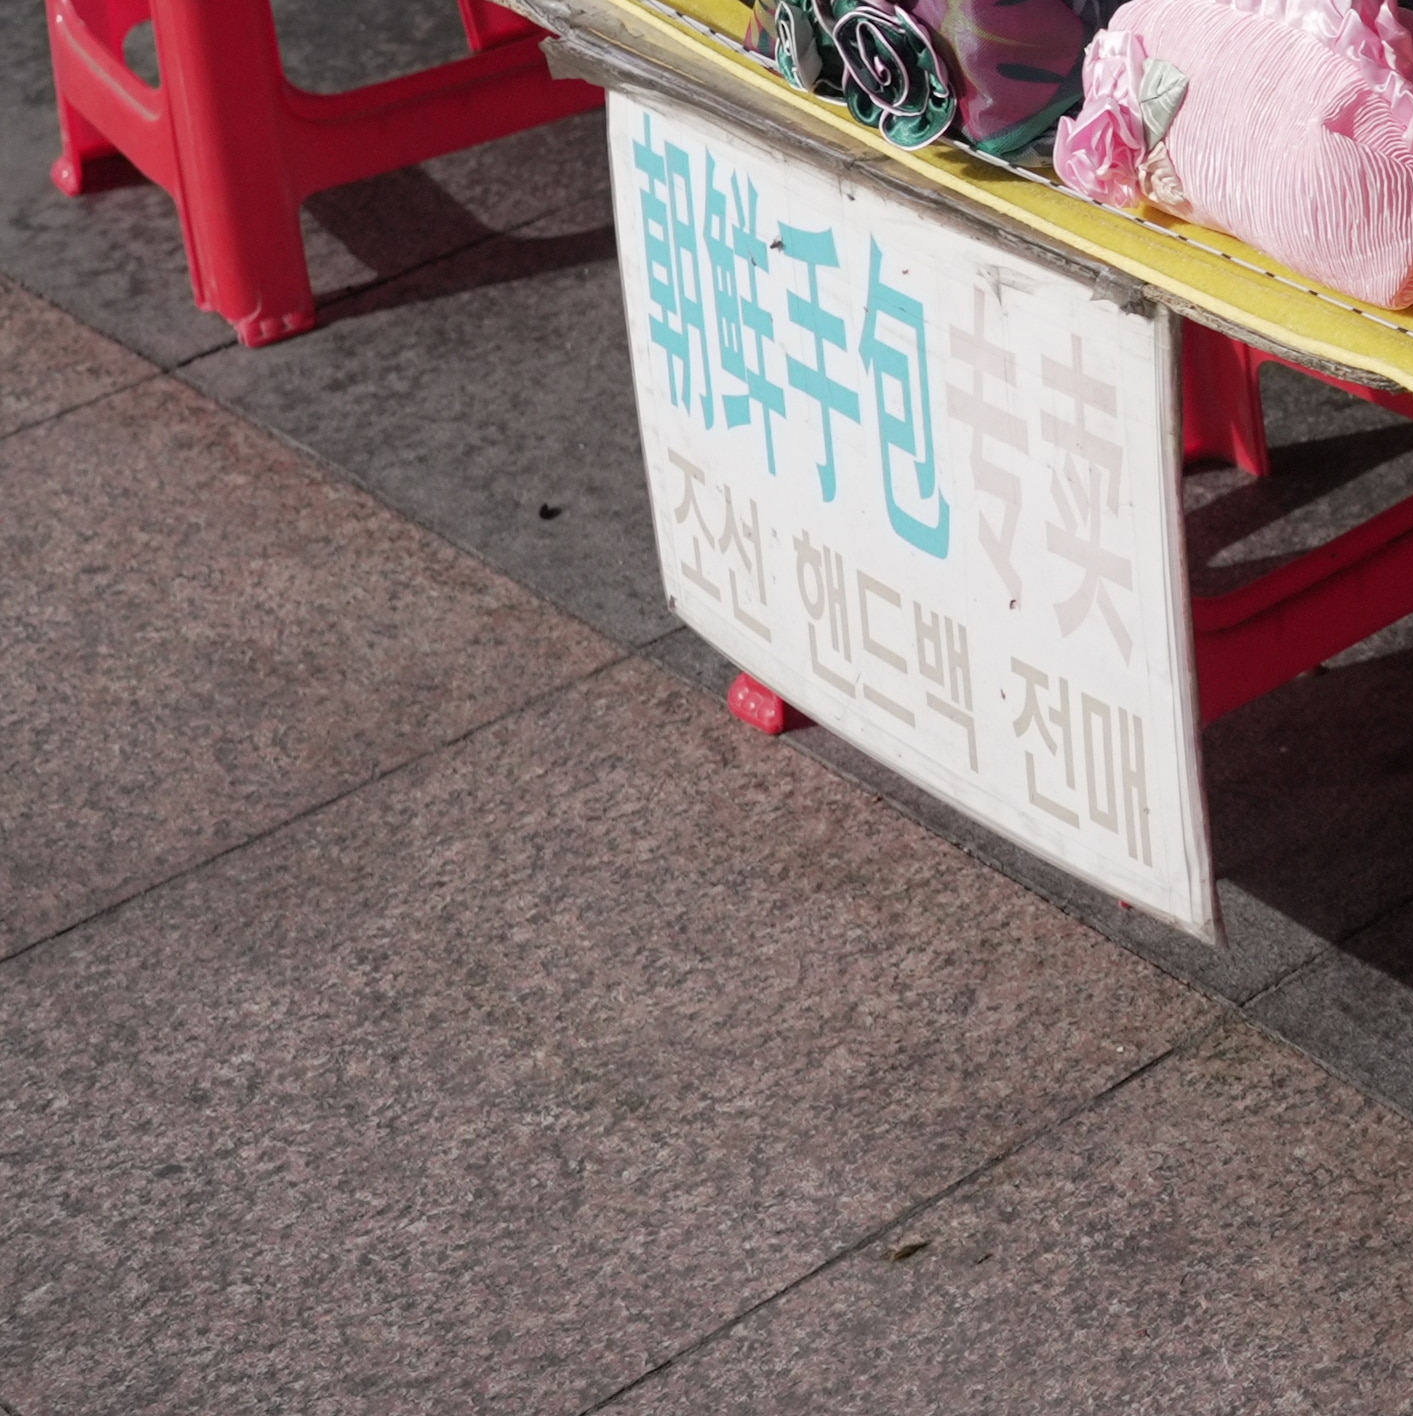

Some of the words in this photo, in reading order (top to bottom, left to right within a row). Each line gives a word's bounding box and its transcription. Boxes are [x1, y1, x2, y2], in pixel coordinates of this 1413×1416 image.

[666, 447, 773, 645] 조선
[792, 527, 980, 774] 핸드백
[1009, 656, 1154, 868] 전매
